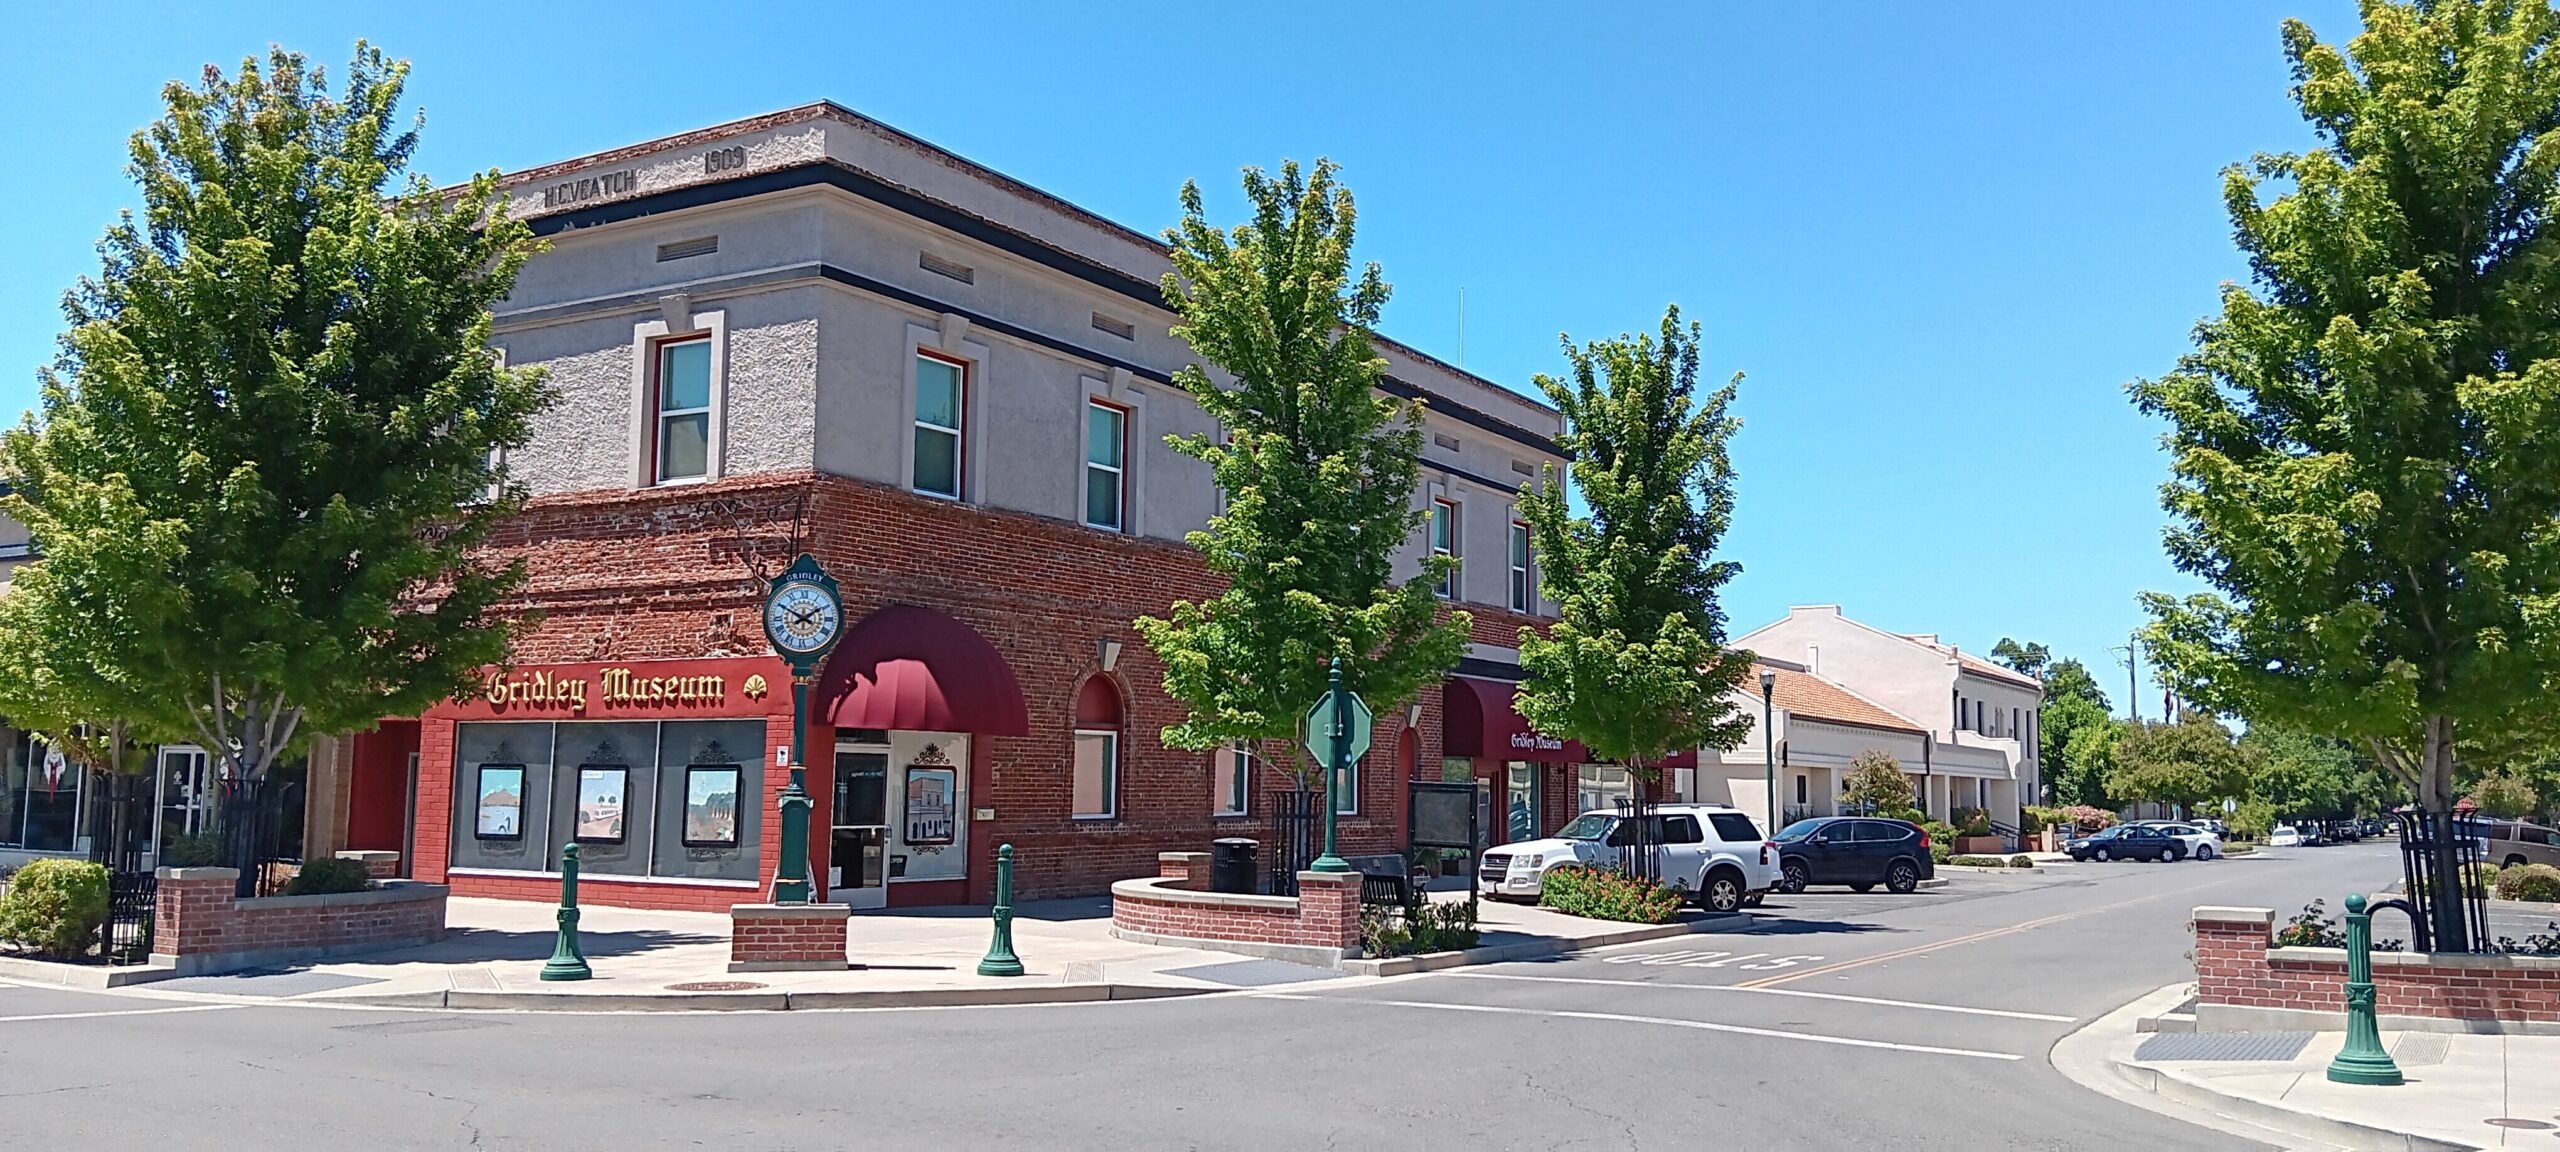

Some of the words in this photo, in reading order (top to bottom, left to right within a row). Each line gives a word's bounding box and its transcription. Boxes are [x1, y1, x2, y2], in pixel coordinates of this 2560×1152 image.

[704, 146, 745, 175] 1909
[786, 572, 824, 583] GRIDLEY
[487, 669, 588, 711] Gridley
[600, 667, 725, 702] Museum
[1511, 733, 1535, 752] Gridley
[1536, 736, 1563, 750] Museum
[1602, 950, 1825, 970] STOP
